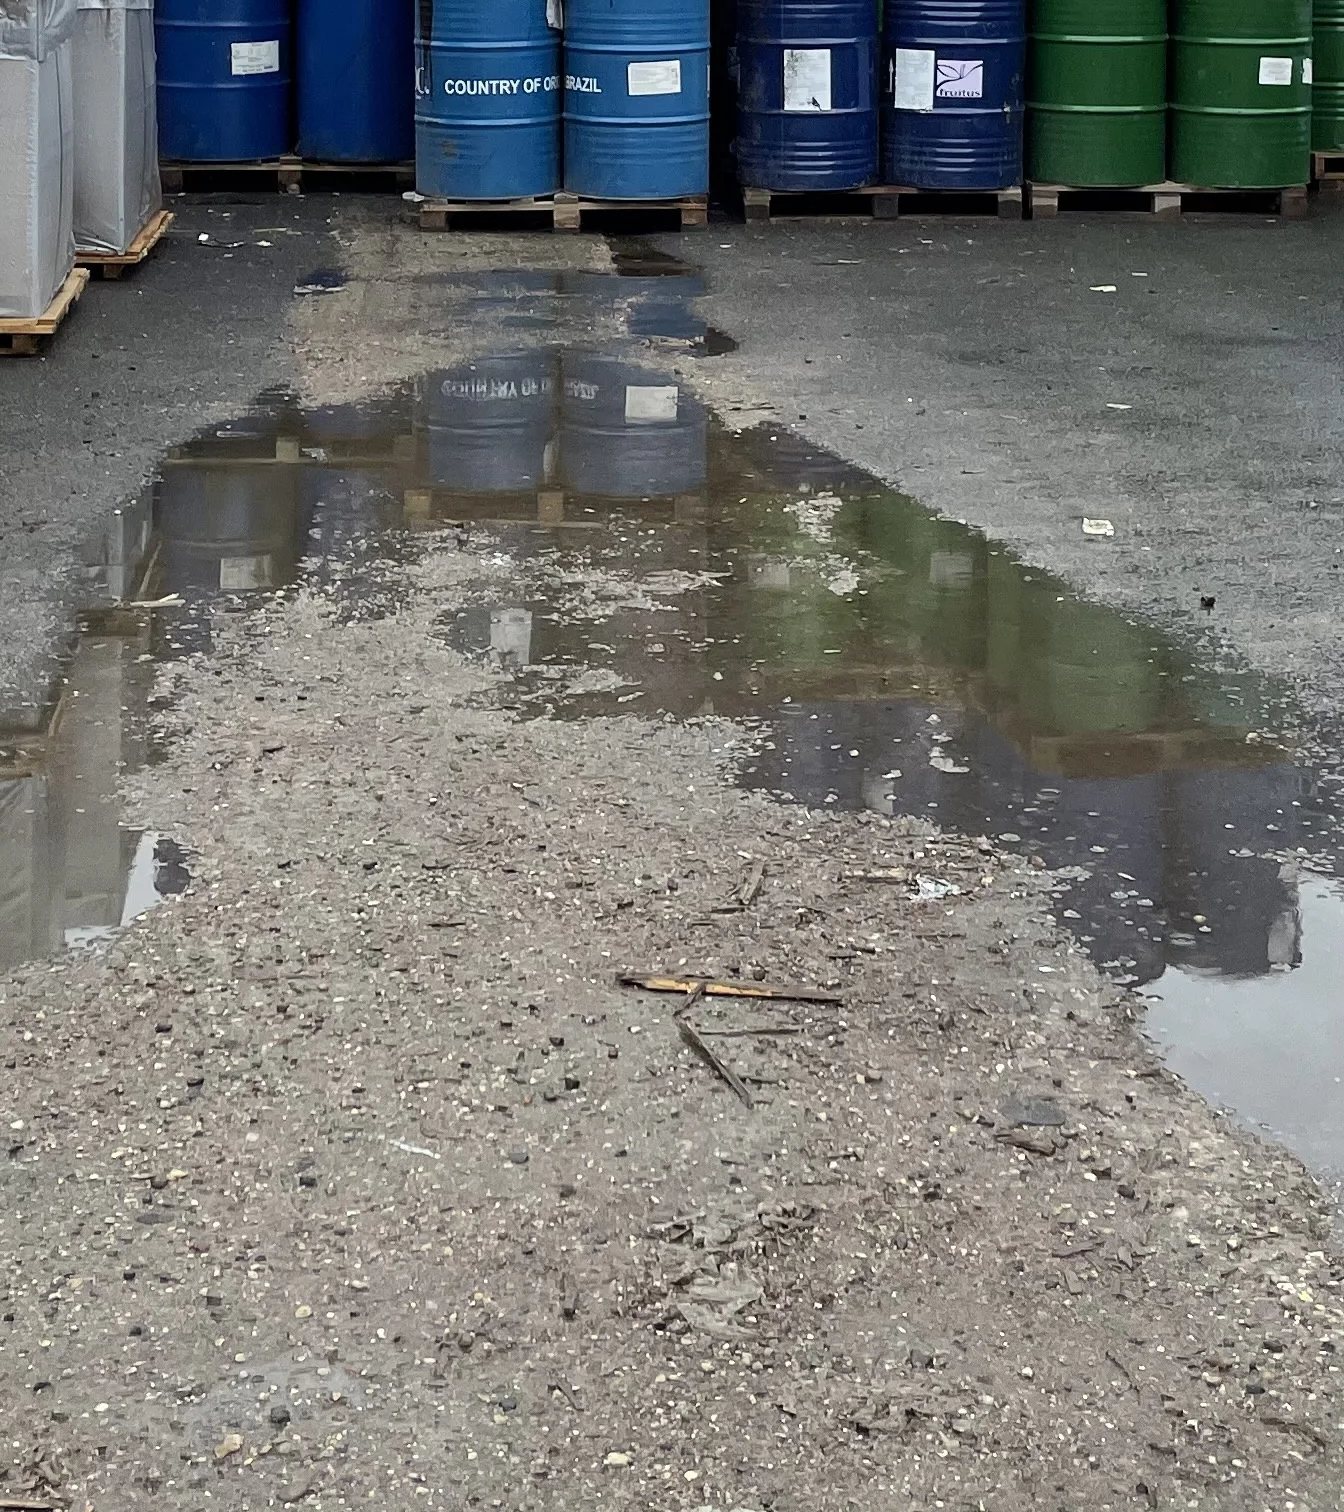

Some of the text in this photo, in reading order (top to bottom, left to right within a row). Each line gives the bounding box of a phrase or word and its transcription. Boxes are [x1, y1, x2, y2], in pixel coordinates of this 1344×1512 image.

[444, 79, 520, 95] COUNTRY
[523, 78, 541, 94] OF
[565, 75, 602, 93] BRAZIL
